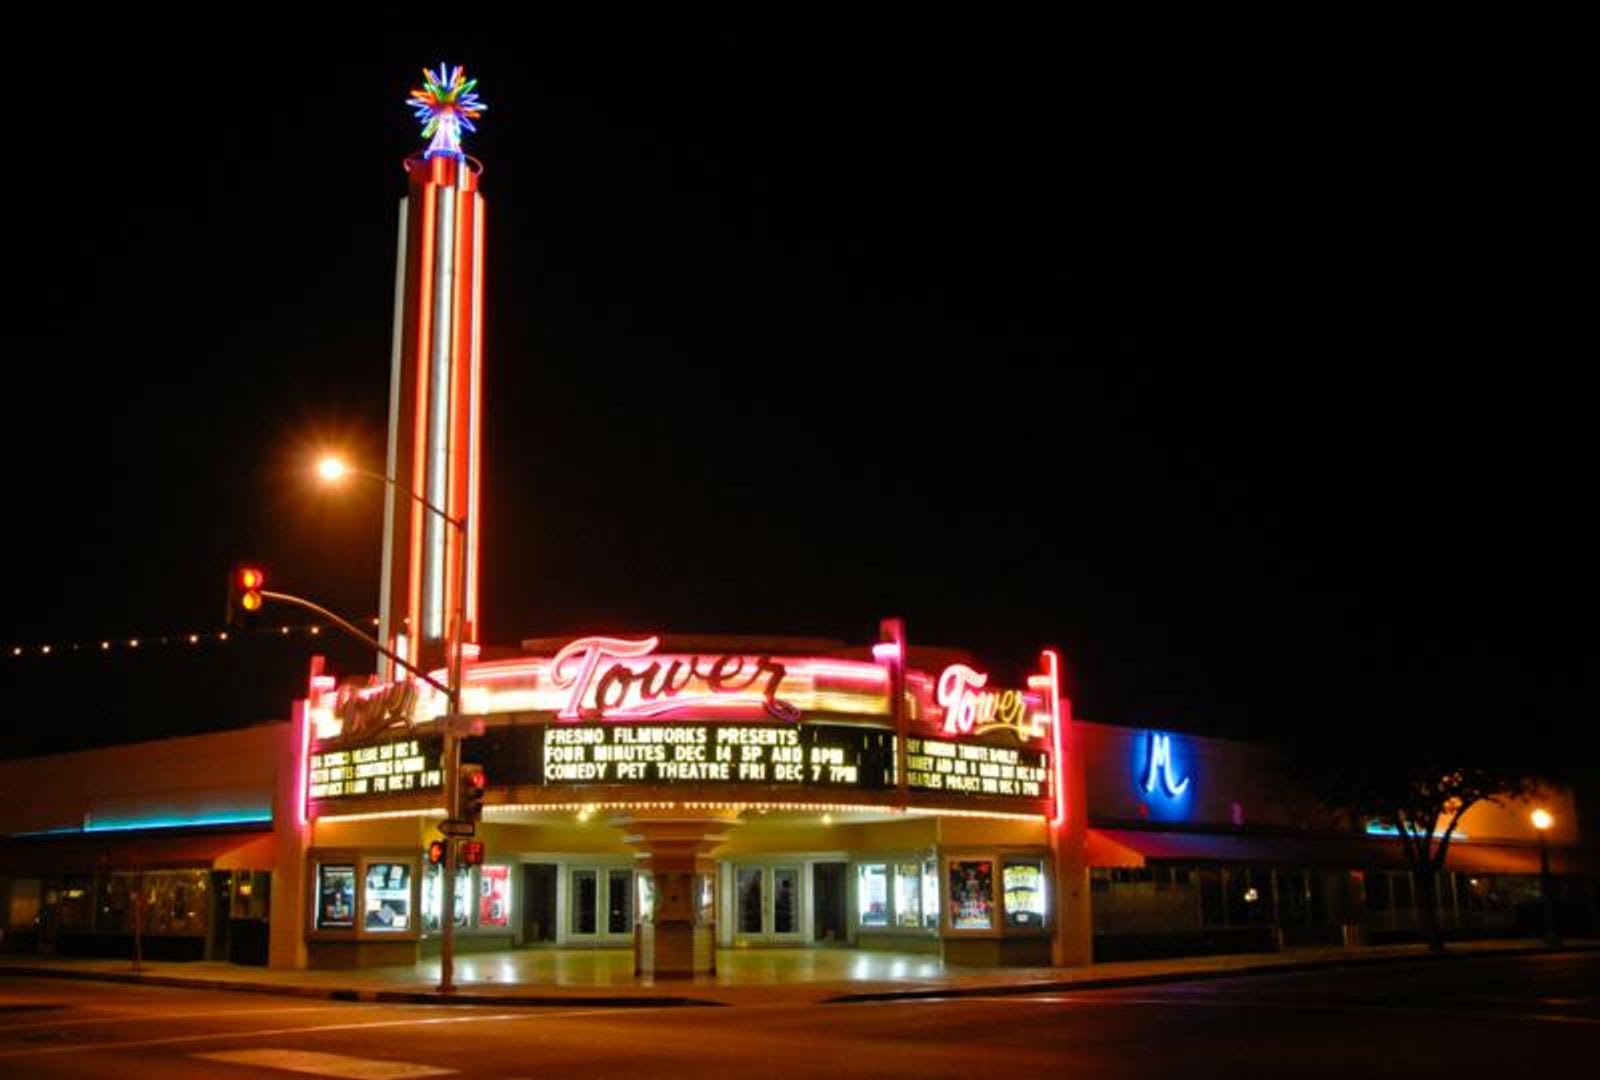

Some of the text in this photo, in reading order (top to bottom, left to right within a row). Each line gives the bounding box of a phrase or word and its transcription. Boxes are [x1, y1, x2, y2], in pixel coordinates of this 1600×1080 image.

[551, 635, 799, 722] Tower
[937, 663, 1030, 742] Tower
[546, 727, 798, 745] FRESNO FILMWORKS PRESENTS
[546, 746, 585, 761] FOUR
[594, 745, 666, 761] MINUTES
[674, 746, 706, 761] DEC
[716, 746, 731, 762] 14
[771, 747, 803, 763] AND
[546, 762, 858, 783] COMEDY PET THEATRE FRI DEC 7 7PM
